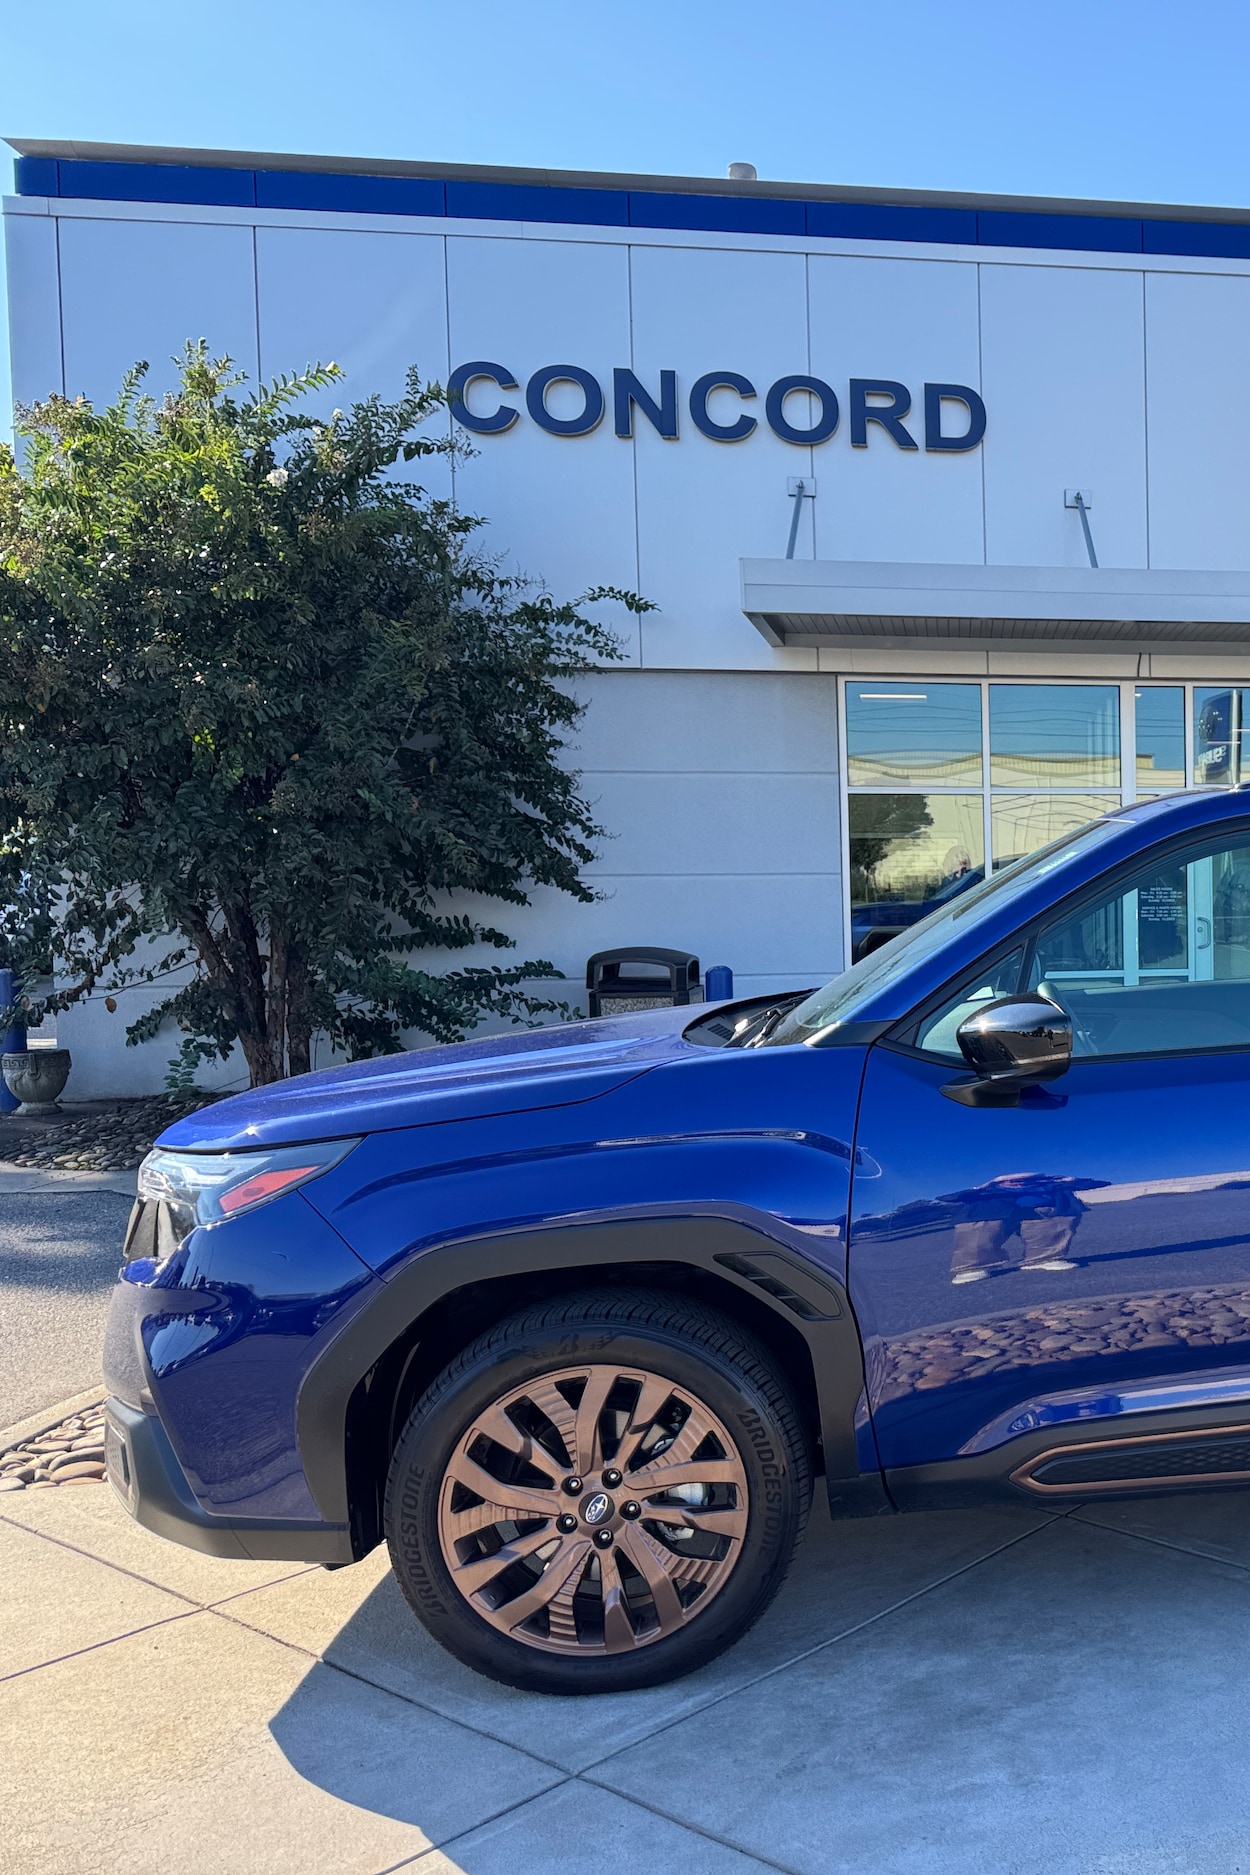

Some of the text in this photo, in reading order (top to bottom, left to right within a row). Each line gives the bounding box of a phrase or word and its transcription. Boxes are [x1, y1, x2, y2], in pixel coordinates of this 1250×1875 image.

[447, 361, 987, 452] CONCORD
[400, 1461, 449, 1617] BRIDGESTONE
[736, 1407, 783, 1557] BRIDGESTONE
